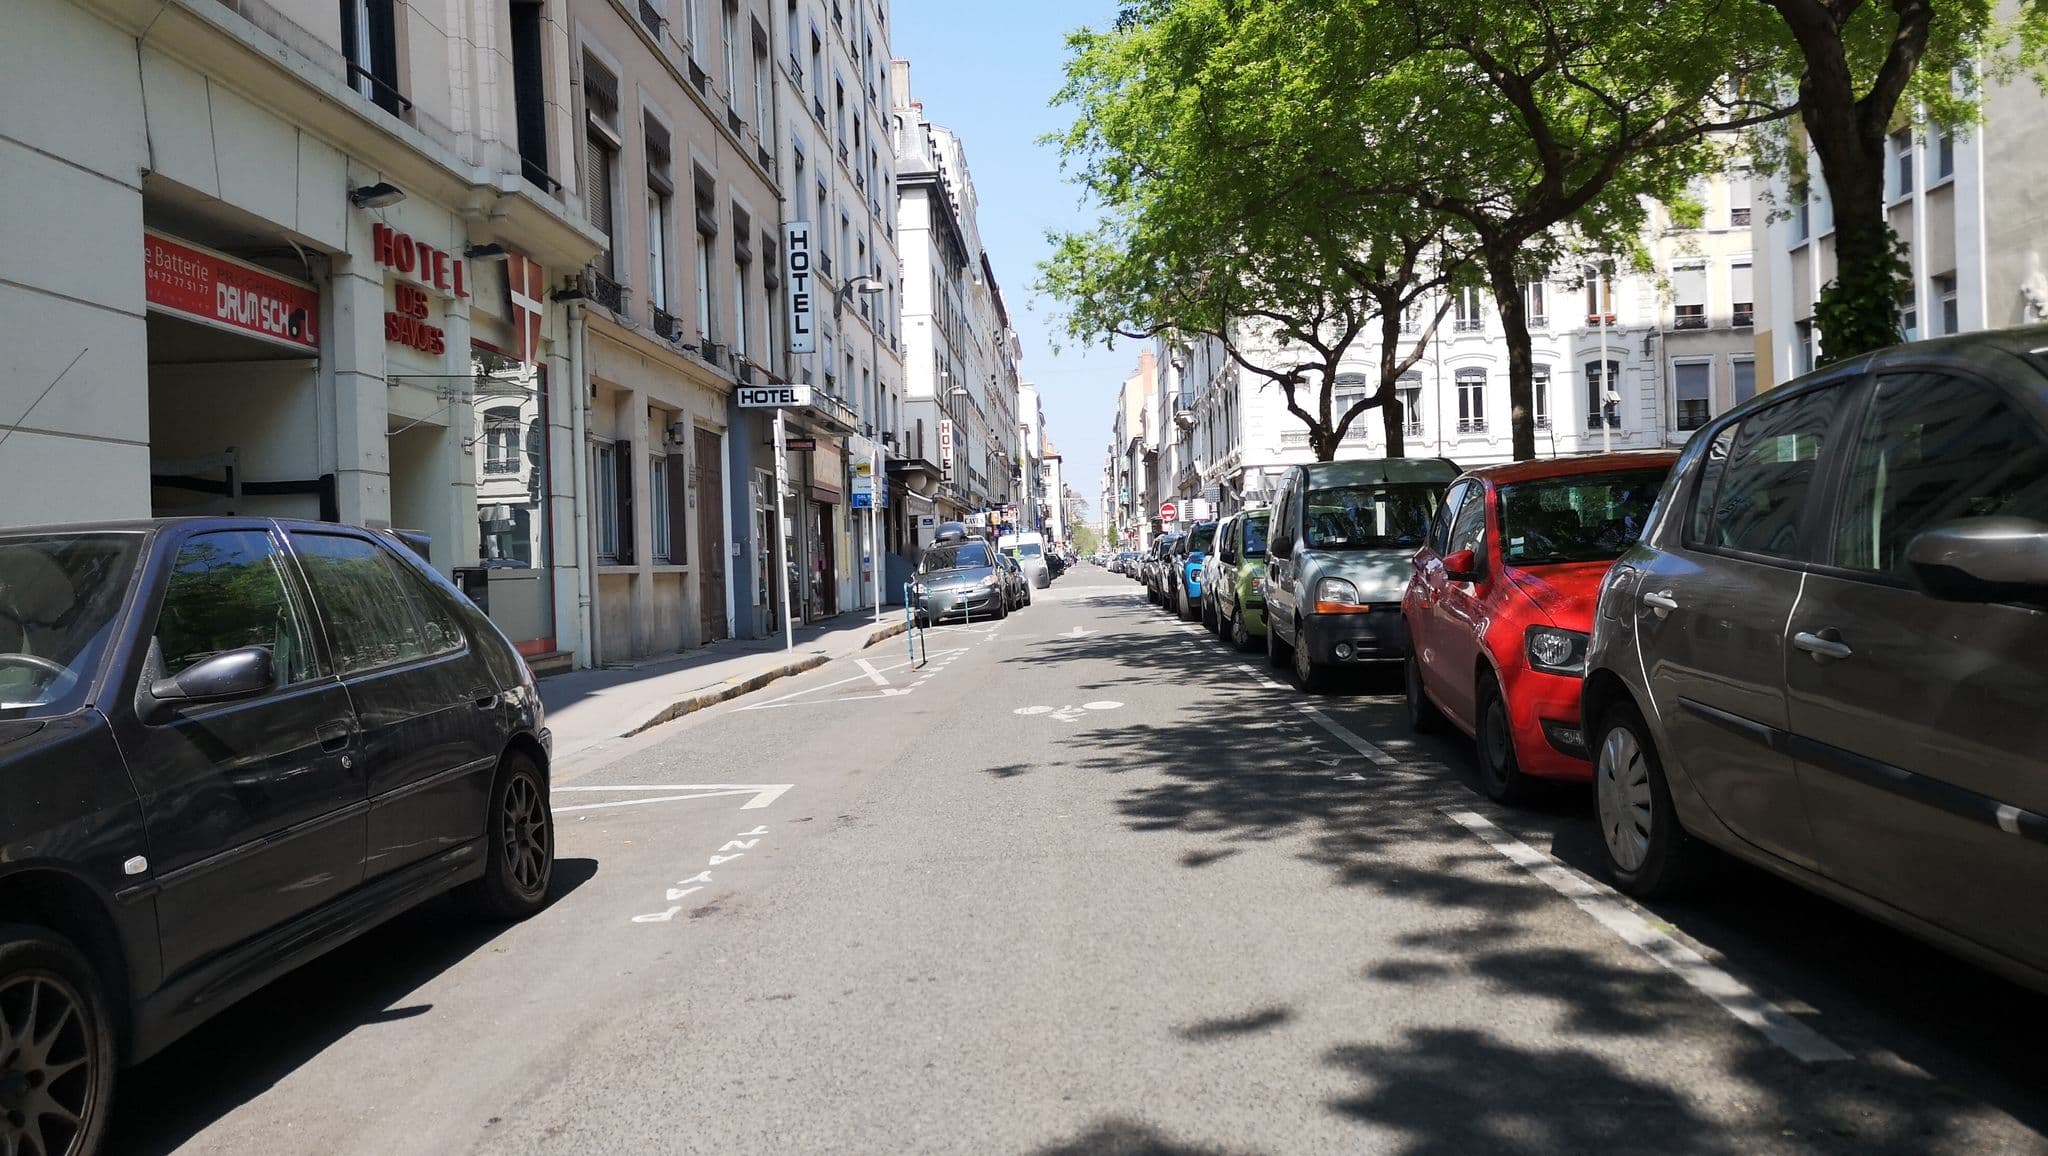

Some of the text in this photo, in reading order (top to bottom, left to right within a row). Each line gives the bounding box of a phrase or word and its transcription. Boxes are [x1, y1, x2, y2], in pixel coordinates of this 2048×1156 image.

[148, 268, 209, 295] 04 72 77 51 77
[155, 246, 209, 282] Batterie
[373, 223, 470, 298] HOTEL
[789, 230, 809, 334] HOTEL
[216, 282, 259, 327] DRUM
[395, 283, 429, 319] DES
[384, 312, 445, 355] SAVOIES
[741, 389, 799, 404] HOTEL
[941, 422, 952, 481] HOTEL
[631, 825, 769, 923] PAYANT
